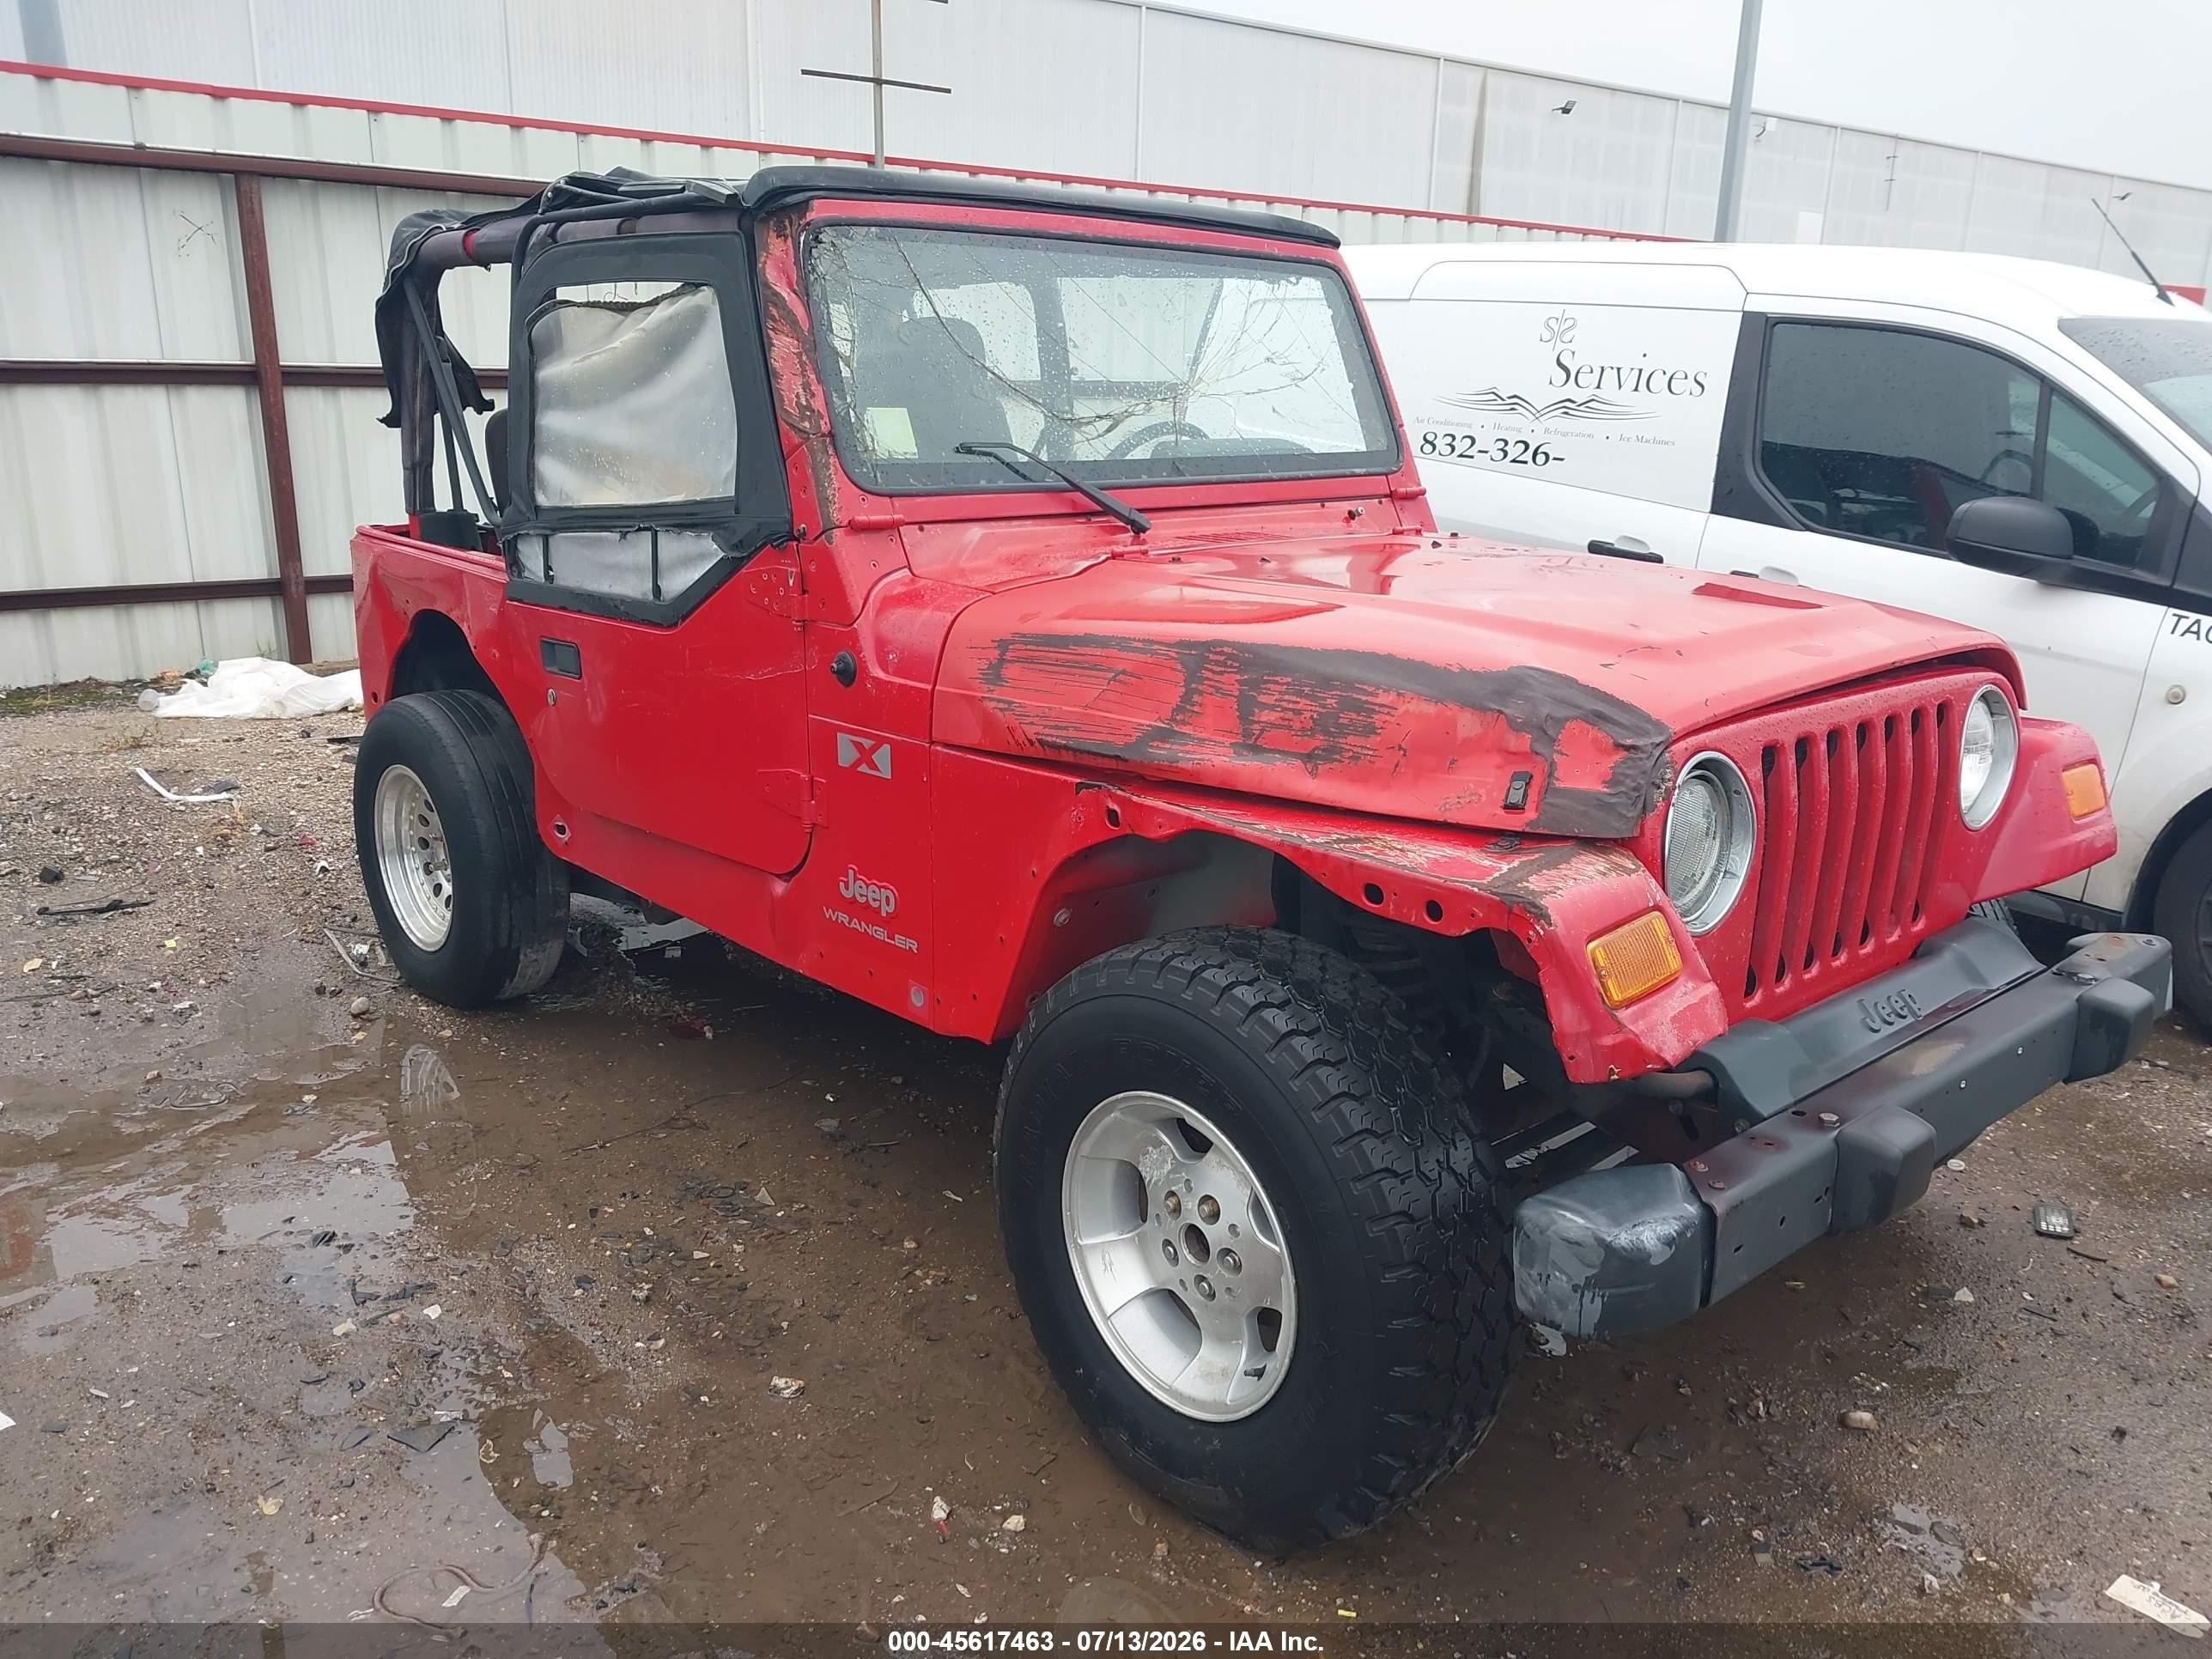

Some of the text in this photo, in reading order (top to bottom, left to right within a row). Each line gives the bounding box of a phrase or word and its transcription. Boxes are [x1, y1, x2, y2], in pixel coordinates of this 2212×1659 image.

[1548, 348, 1708, 398] Services
[1419, 431, 1566, 467] 832-326-
[1427, 416, 1474, 429] Conditioning
[1492, 422, 1523, 434] Heating
[1543, 426, 1595, 440] Refrigeration
[1619, 433, 1633, 442] Ice
[1634, 434, 1677, 447] Machines
[839, 867, 896, 918] Jeep
[823, 906, 919, 953] WRANGLER
[1856, 989, 1923, 1033] Jeep
